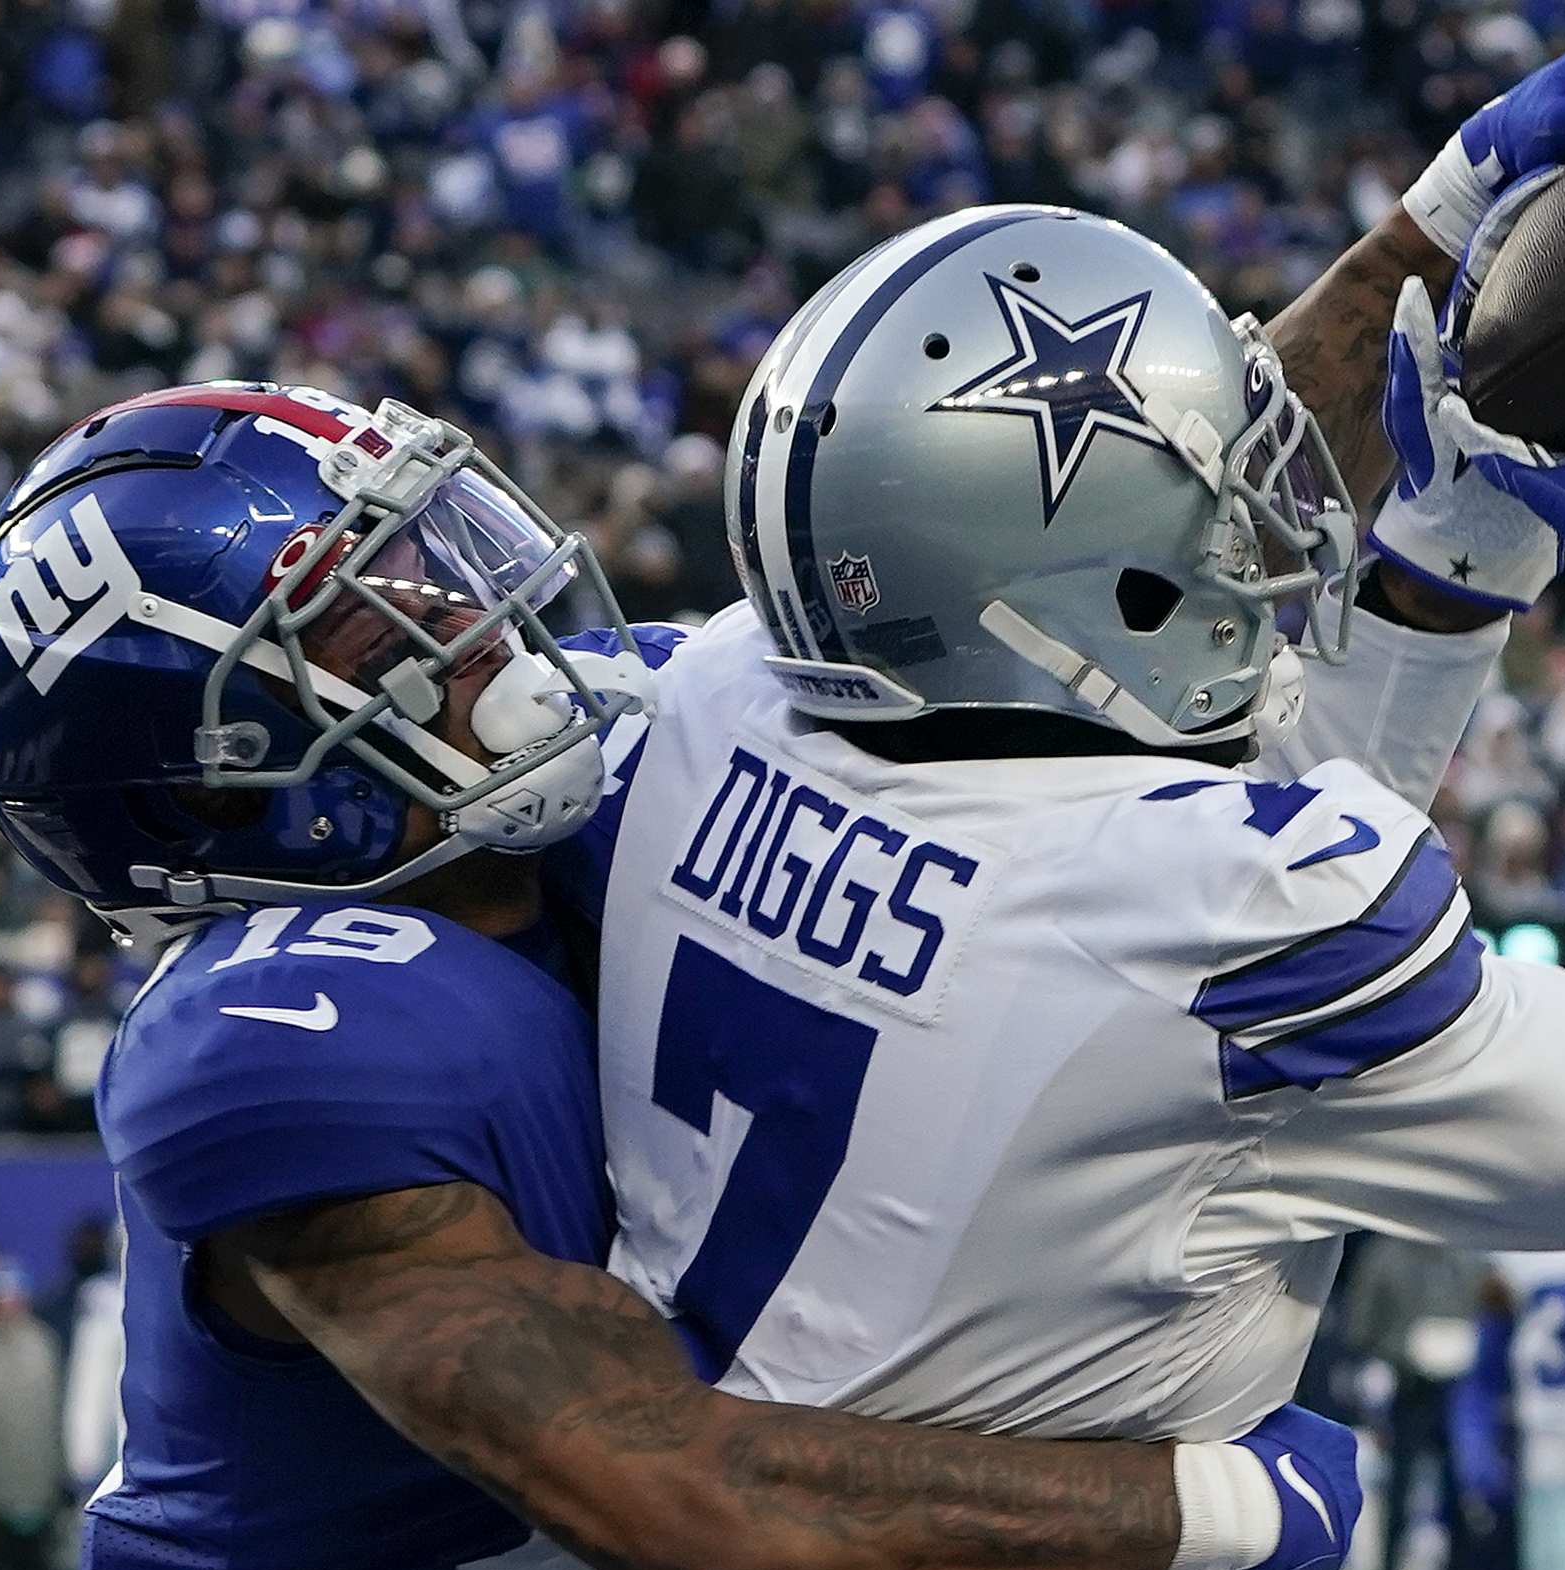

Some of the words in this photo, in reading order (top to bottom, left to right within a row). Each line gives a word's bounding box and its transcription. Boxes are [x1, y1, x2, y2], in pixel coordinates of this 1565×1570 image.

[836, 579, 875, 606] NFL
[205, 906, 438, 974] 19
[671, 746, 980, 997] DIGGS
[651, 933, 879, 1388] 7
